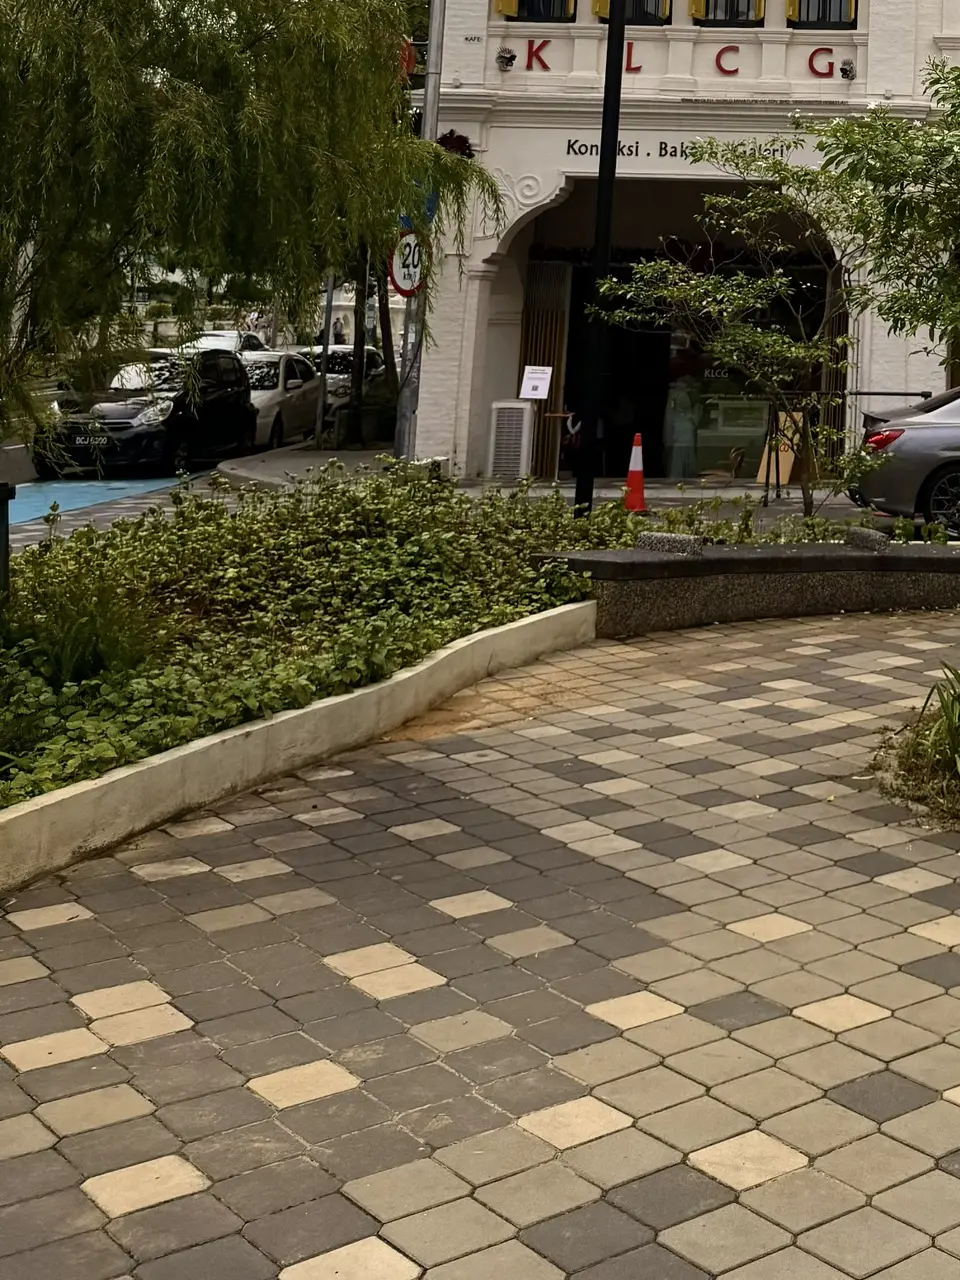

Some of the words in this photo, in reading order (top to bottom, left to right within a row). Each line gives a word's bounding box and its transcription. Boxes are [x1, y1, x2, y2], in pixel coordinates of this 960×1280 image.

[525, 39, 551, 71] K
[625, 41, 643, 73] L
[715, 45, 740, 75] C
[808, 47, 835, 79] G
[566, 139, 640, 157] Konksi
[401, 242, 421, 268] 20
[704, 368, 729, 378] KLCG
